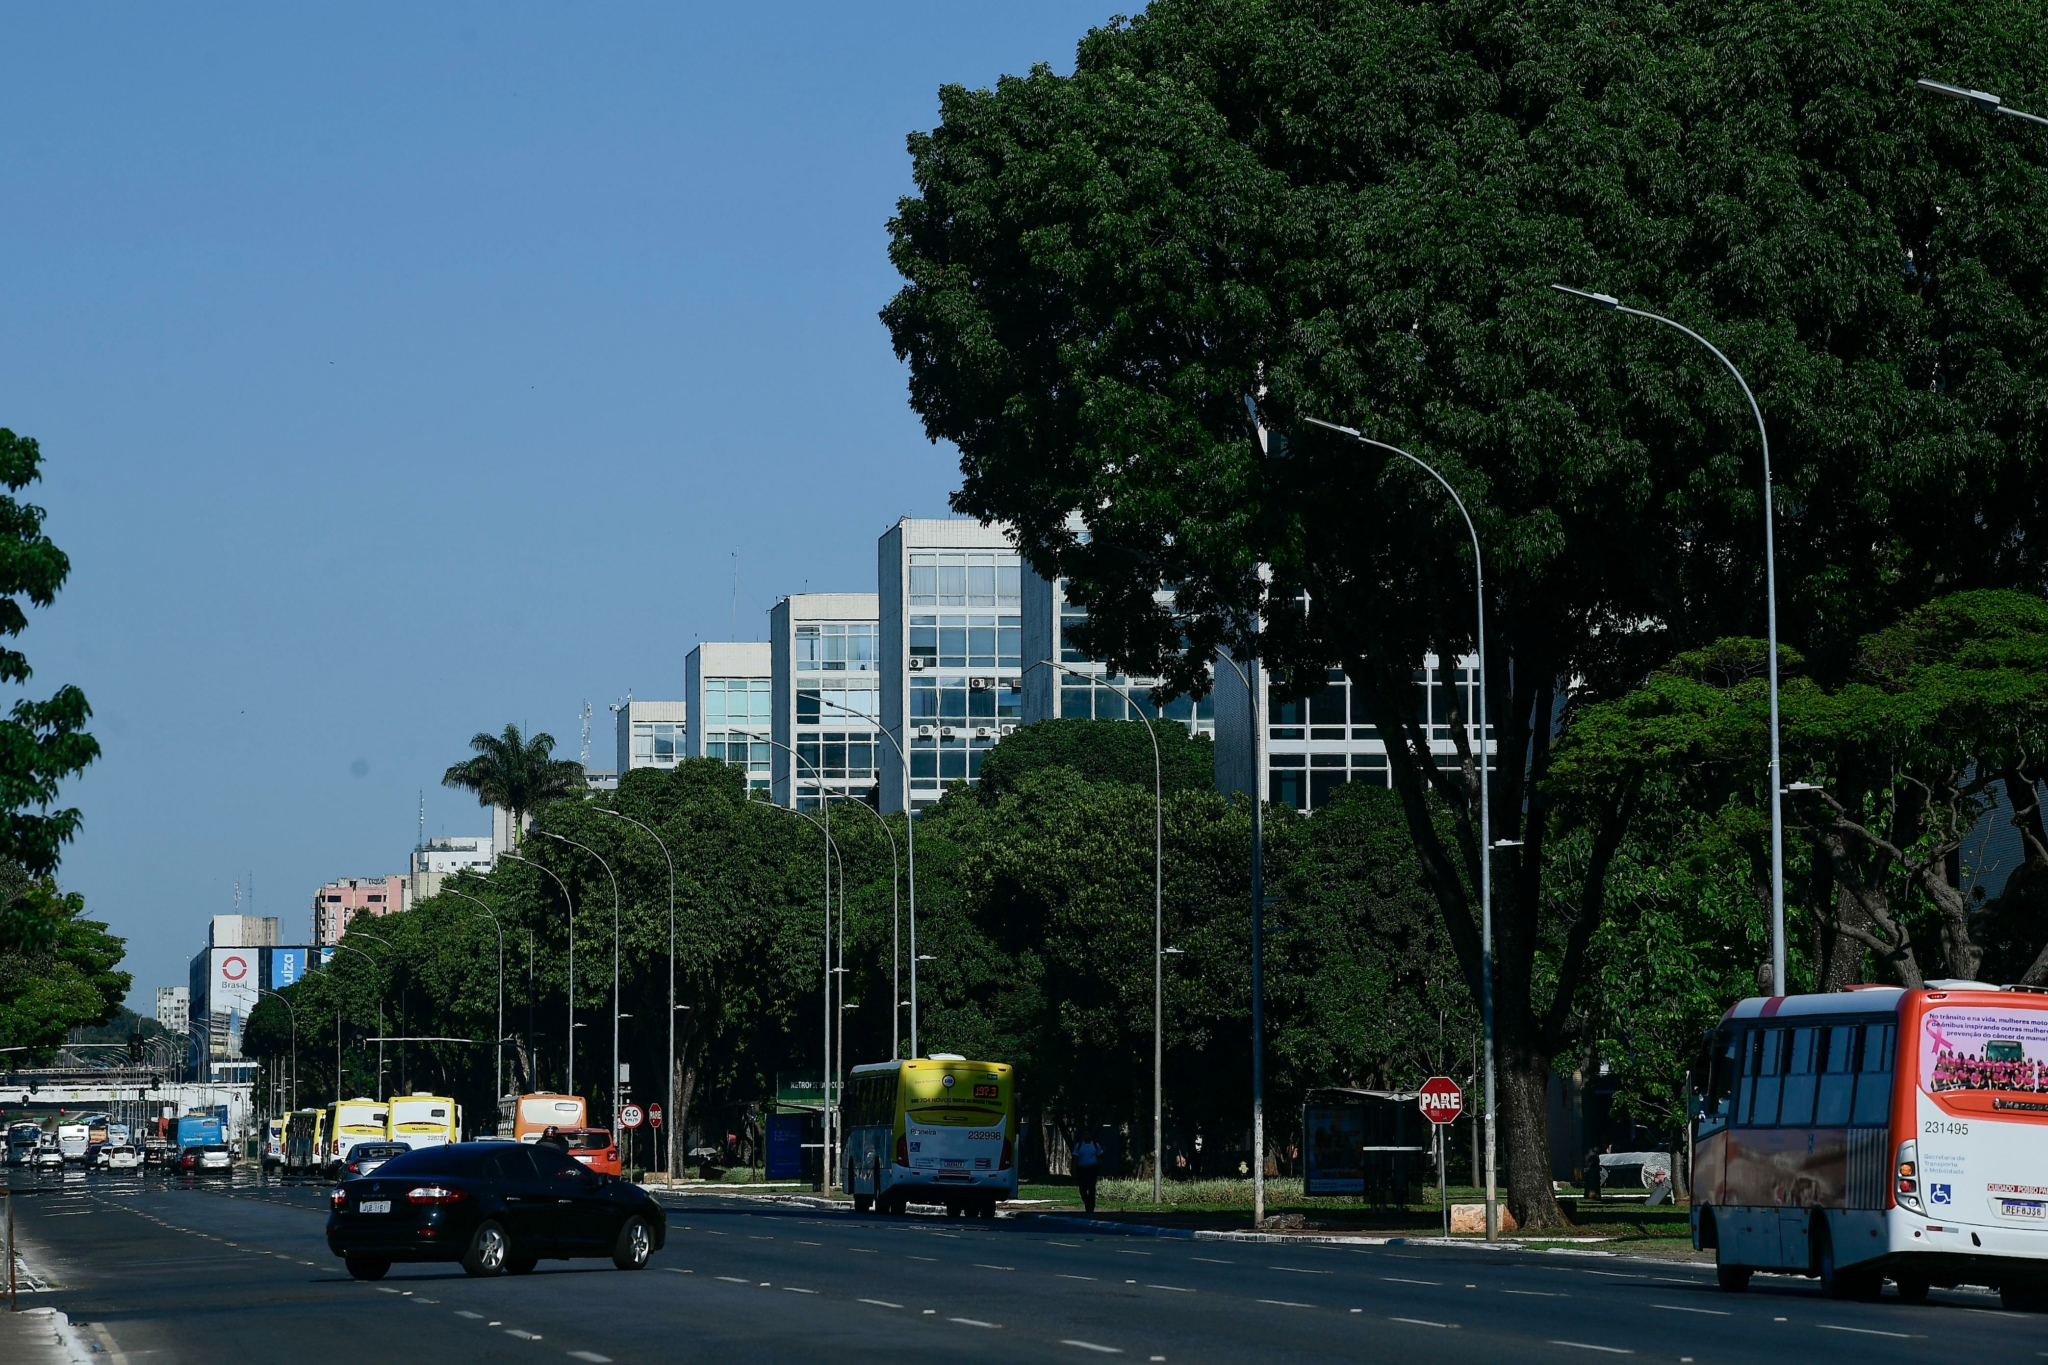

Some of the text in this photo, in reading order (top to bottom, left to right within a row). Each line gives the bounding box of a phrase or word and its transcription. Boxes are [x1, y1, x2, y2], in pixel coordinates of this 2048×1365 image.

[281, 954, 294, 984] uiza
[221, 980, 248, 989] Brasal
[1939, 1013, 1966, 1021] trânsito
[1981, 1015, 1997, 1023] vida,
[1998, 1017, 2030, 1025] mulheres
[1941, 1021, 1964, 1029] ônibus
[1964, 1023, 2000, 1031] inspirando
[1946, 1030, 1982, 1039] prevenção
[1992, 1031, 2015, 1039] câncer
[1421, 1092, 1460, 1110] PARE
[625, 1109, 639, 1117] 60
[649, 1110, 661, 1120] PARE
[910, 1128, 937, 1136] Pioneira
[1924, 1120, 1969, 1136] 231495
[968, 1131, 1001, 1141] 232998
[1924, 1153, 1956, 1161] Secretaria
[1929, 1167, 1964, 1175] Mobilidade
[1988, 1184, 2015, 1192] CUIDADO
[2018, 1185, 2037, 1194] POSSO
[2005, 1205, 2042, 1216] REF8J38
